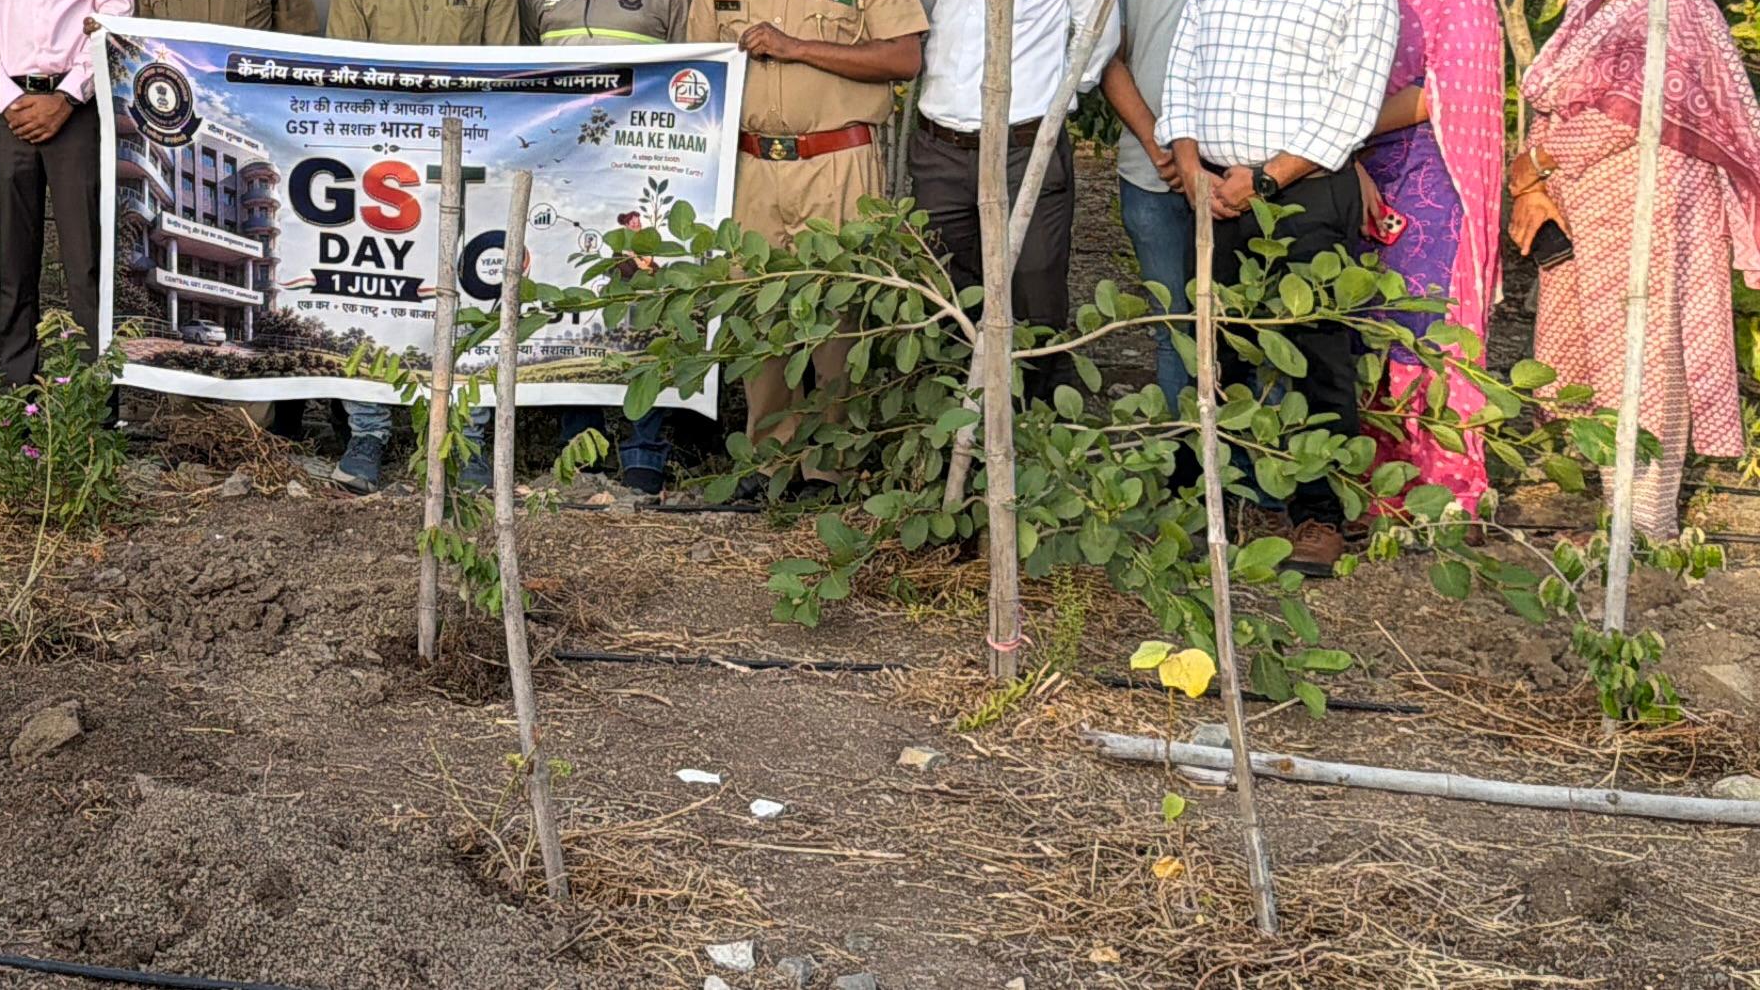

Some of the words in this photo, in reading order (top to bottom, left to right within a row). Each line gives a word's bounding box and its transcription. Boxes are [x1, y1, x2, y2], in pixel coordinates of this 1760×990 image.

[292, 67, 325, 86] वस्तु
[329, 66, 359, 85] और
[362, 68, 395, 86] सेवा
[399, 73, 424, 87] कर
[553, 74, 621, 89] जामनगर
[290, 96, 309, 114] देश
[314, 97, 330, 113] की
[334, 98, 375, 115] तरक्की
[380, 99, 391, 116] में
[393, 102, 434, 116] आपका
[438, 101, 487, 120] योगदान,
[286, 119, 320, 135] GST
[323, 119, 335, 135] से
[339, 123, 376, 137] सशक्त
[380, 121, 424, 139] भारत
[630, 110, 646, 127] EK
[650, 111, 675, 128] PED
[614, 130, 644, 147] MAA
[648, 131, 664, 149] KE
[668, 133, 707, 154] NAAM
[610, 161, 623, 169] Our
[648, 163, 660, 171] and
[319, 231, 415, 271] DAY
[331, 274, 341, 292] 1
[347, 275, 407, 297] JULY
[297, 300, 313, 310] एक
[315, 301, 330, 310] कर
[342, 303, 358, 313] एक
[360, 304, 379, 318] राष्ट्र
[391, 306, 406, 317] एक
[474, 344, 491, 356] कर
[540, 345, 575, 356] सशक्त
[578, 345, 608, 359] भारत
